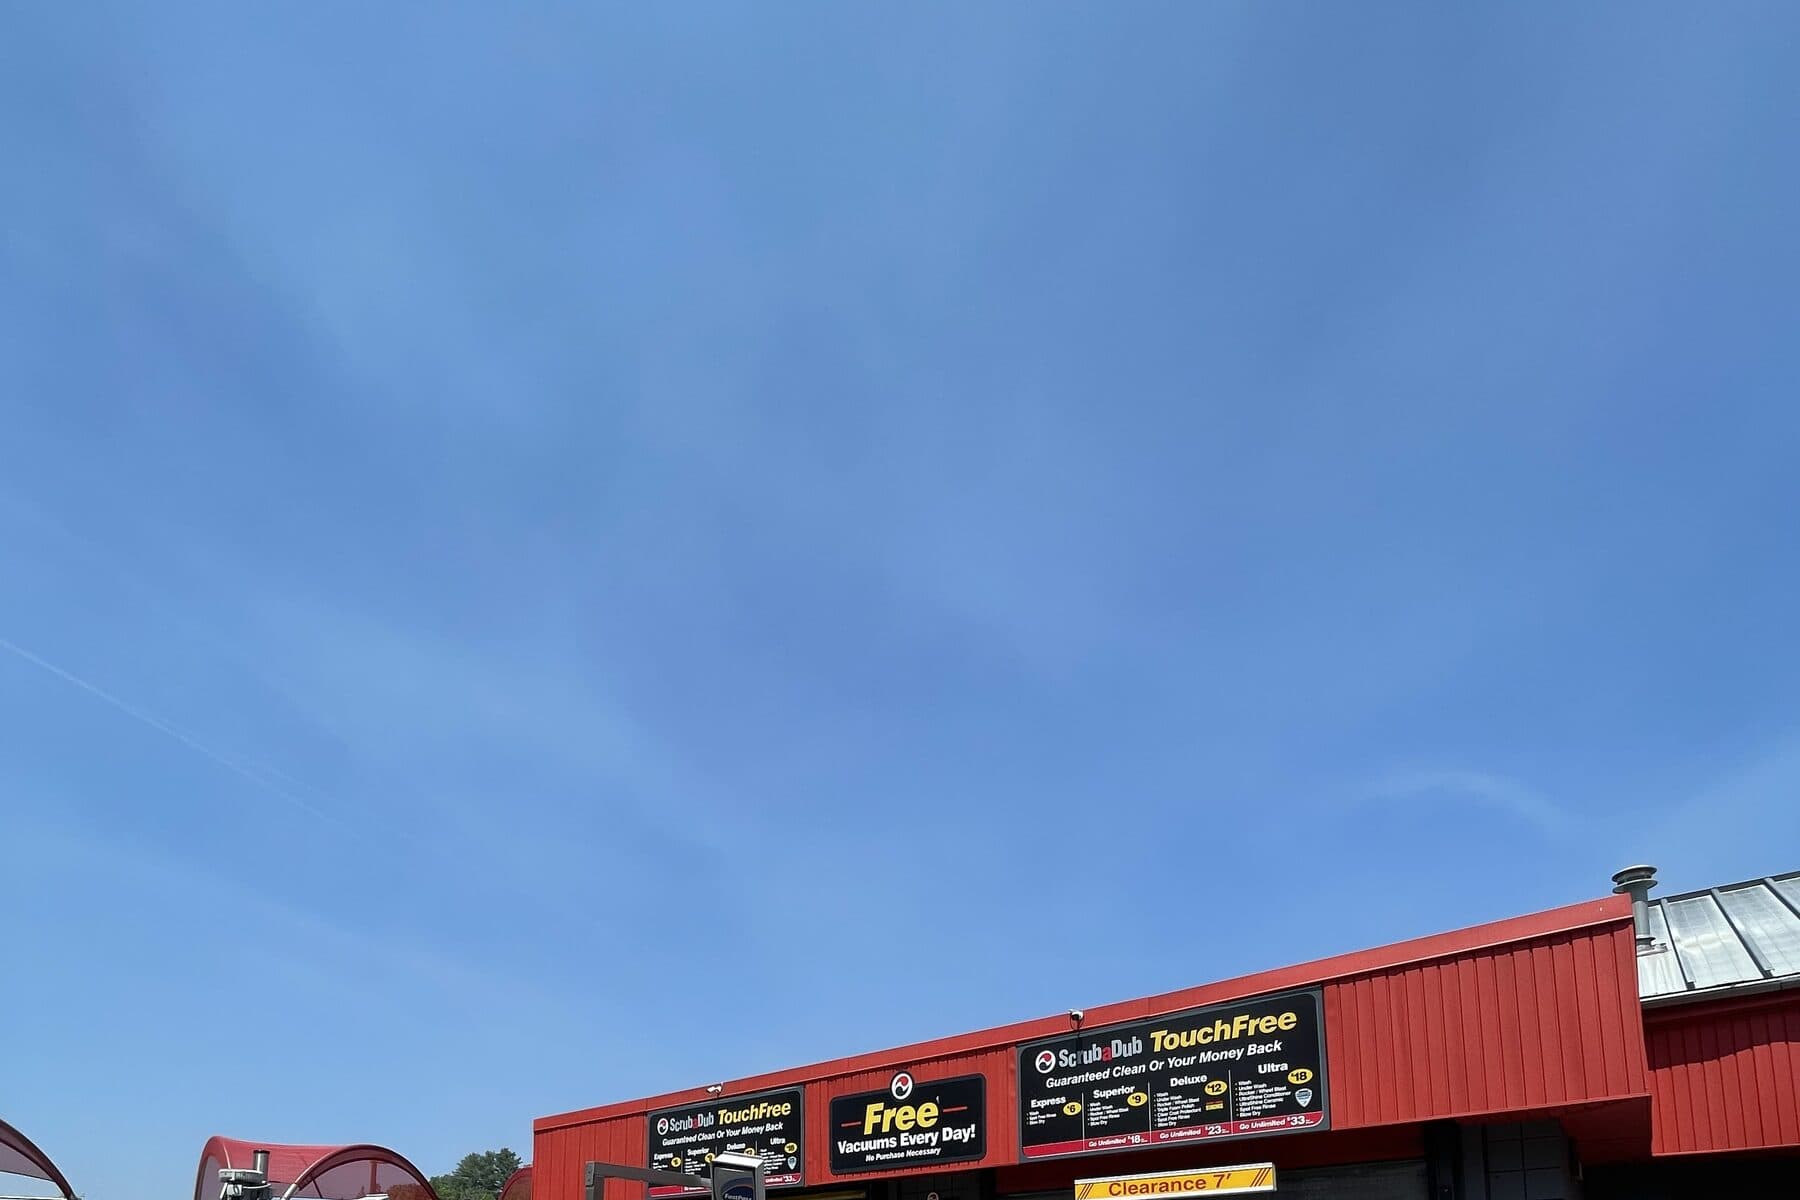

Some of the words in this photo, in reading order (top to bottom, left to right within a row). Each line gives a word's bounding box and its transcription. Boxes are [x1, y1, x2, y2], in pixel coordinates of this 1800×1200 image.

[1058, 1036, 1143, 1068] ScrubaDub
[1150, 1011, 1297, 1053] TouchFree
[1046, 1069, 1110, 1088] Guaranteed
[1112, 1064, 1146, 1078] Clean
[1149, 1060, 1164, 1072] Or
[1167, 1055, 1197, 1069] Your
[1199, 1049, 1245, 1064] Money
[1246, 1040, 1283, 1056] Back
[1258, 1062, 1289, 1074] Ultra
[1170, 1074, 1208, 1087] Deluxe
[1291, 1071, 1307, 1081] $18
[1093, 1085, 1135, 1099] Superior
[1207, 1083, 1222, 1093] $12
[1031, 1096, 1066, 1108] Express
[717, 1102, 791, 1125] TouchFree
[863, 1102, 939, 1136] Free
[1251, 1119, 1285, 1128] Unlimited
[1287, 1115, 1305, 1126] $33
[662, 1134, 697, 1146] Guaranteed
[697, 1132, 716, 1141] Clean
[716, 1130, 725, 1139] Or
[725, 1128, 741, 1138] Your
[741, 1125, 765, 1135] Money
[765, 1122, 783, 1132] Back
[837, 1136, 897, 1154] Vacuums
[900, 1131, 939, 1147] Every
[942, 1124, 976, 1143] Day!
[1170, 1128, 1201, 1138] Unlimited
[1205, 1126, 1222, 1136] $23
[1098, 1137, 1127, 1146] Unlimited
[865, 1154, 875, 1162] No
[875, 1151, 905, 1161] Purchase
[906, 1148, 941, 1158] Necessary
[1108, 1178, 1206, 1196] Clearance
[1212, 1173, 1232, 1189] 7'
